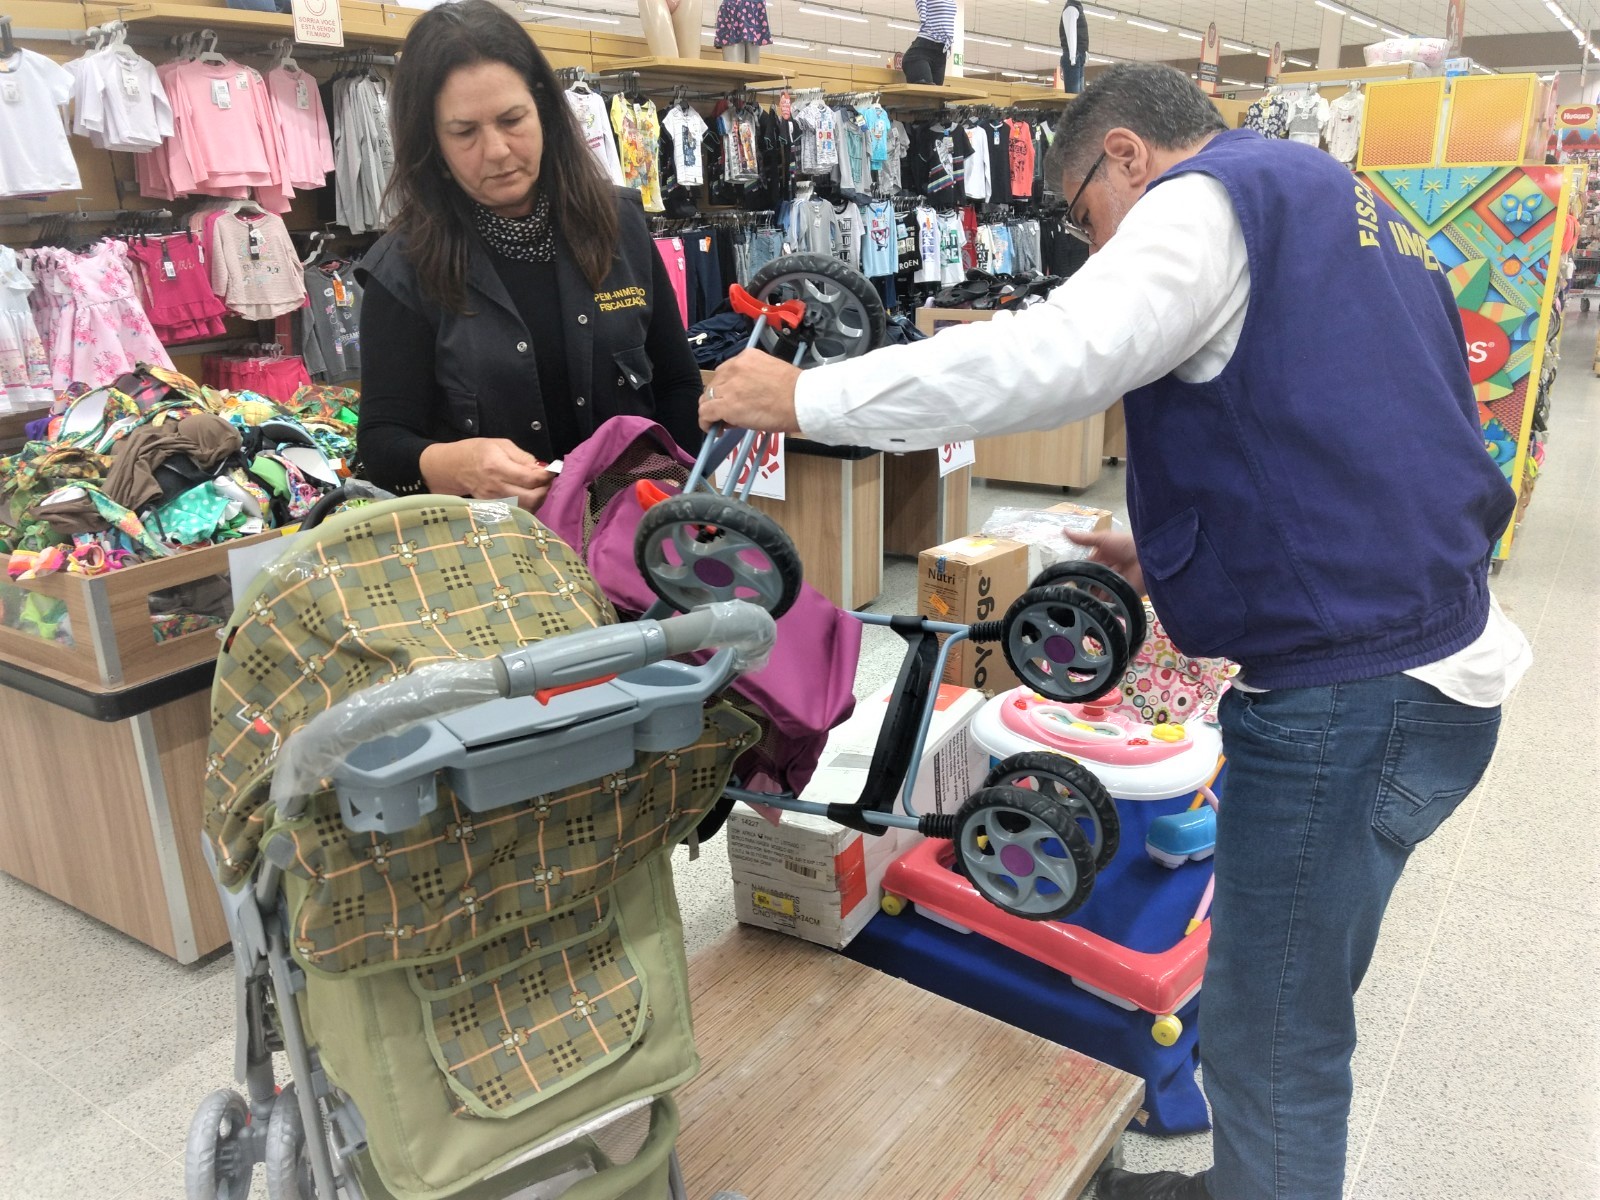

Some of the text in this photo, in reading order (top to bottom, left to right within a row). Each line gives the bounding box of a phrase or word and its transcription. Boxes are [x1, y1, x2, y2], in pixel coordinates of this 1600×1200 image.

[299, 16, 320, 25] SORRIA
[316, 25, 336, 33] SENDO
[306, 31, 331, 39] FILMADO
[928, 567, 956, 585] Nutri
